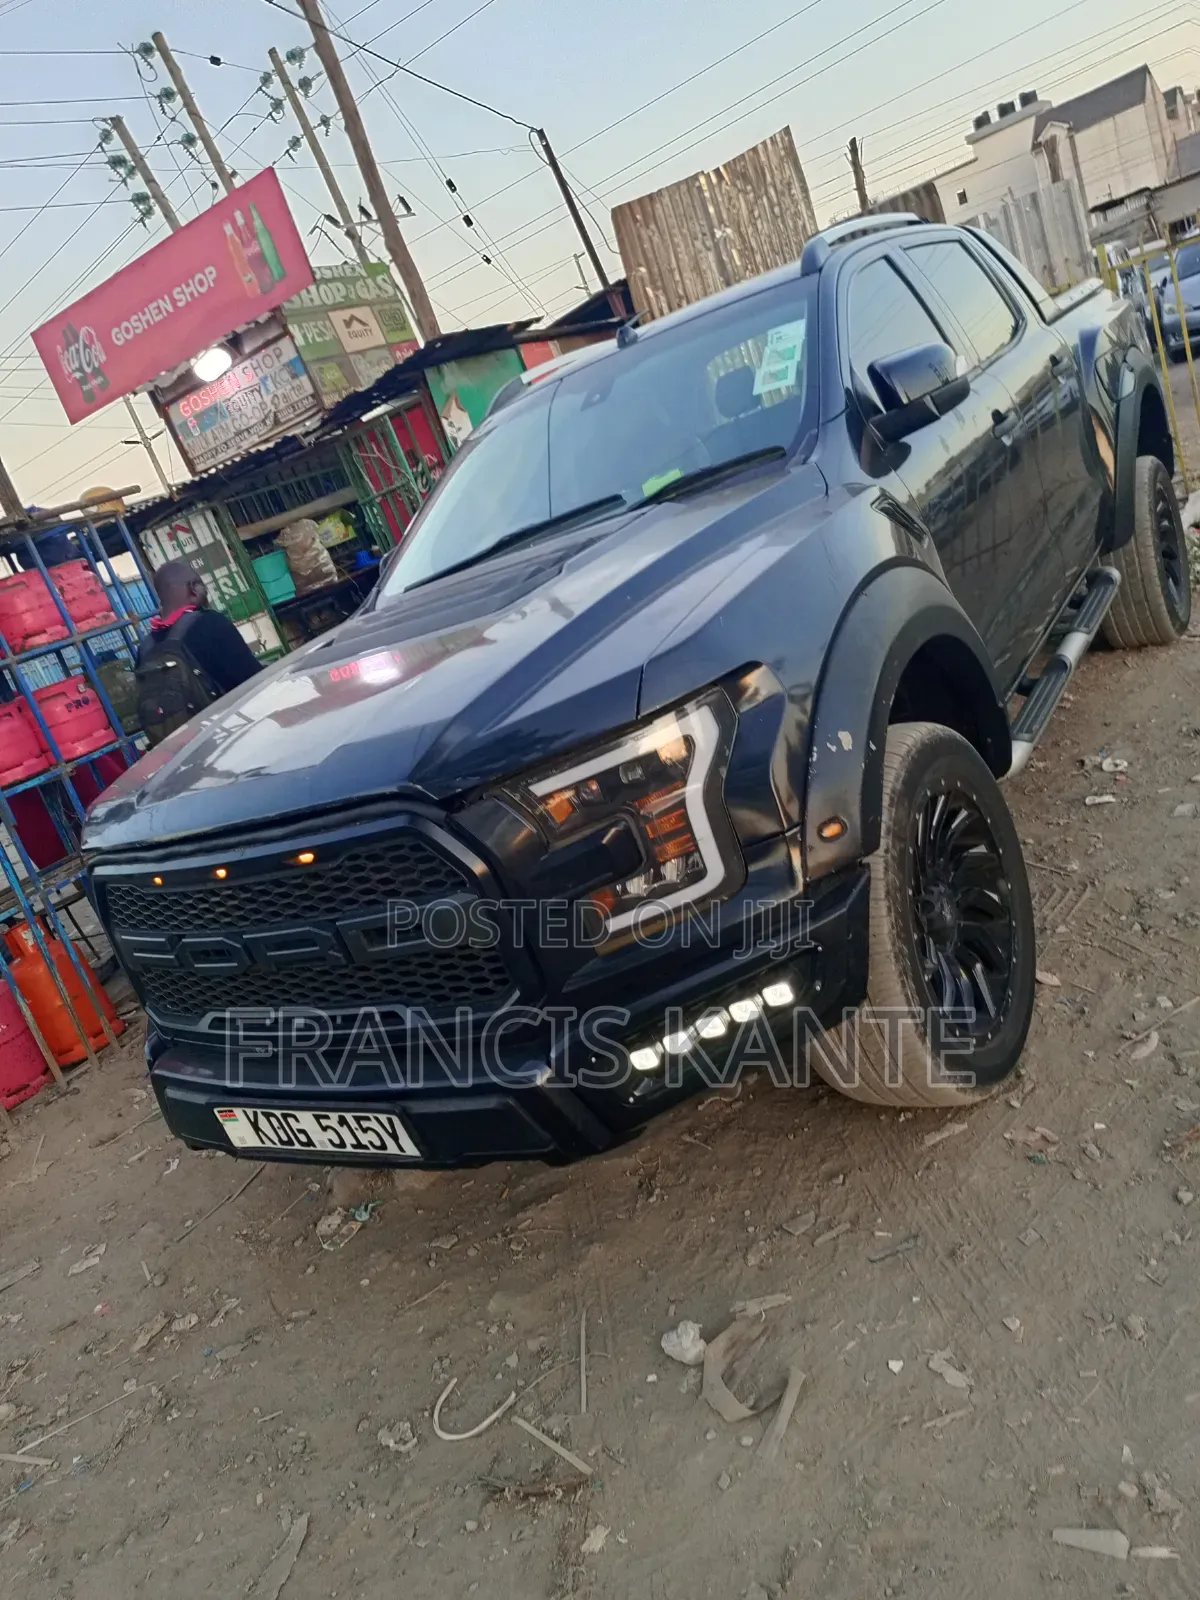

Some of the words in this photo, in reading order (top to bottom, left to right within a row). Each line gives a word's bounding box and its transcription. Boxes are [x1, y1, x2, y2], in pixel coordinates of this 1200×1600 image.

[355, 272, 396, 301] GAS
[111, 294, 174, 346] GOSHEN
[172, 265, 217, 308] SHOP
[347, 327, 374, 340] EQUITY
[56, 326, 107, 384] Coca-Cola
[179, 371, 241, 418] GOSHEN
[241, 347, 284, 384] SHOP
[226, 384, 264, 415] EQUITY
[281, 377, 307, 404] airtel
[231, 400, 268, 431] CO-OP
[117, 893, 481, 972] FORD
[243, 1109, 317, 1149] KDG
[312, 1113, 407, 1153] 515Y
